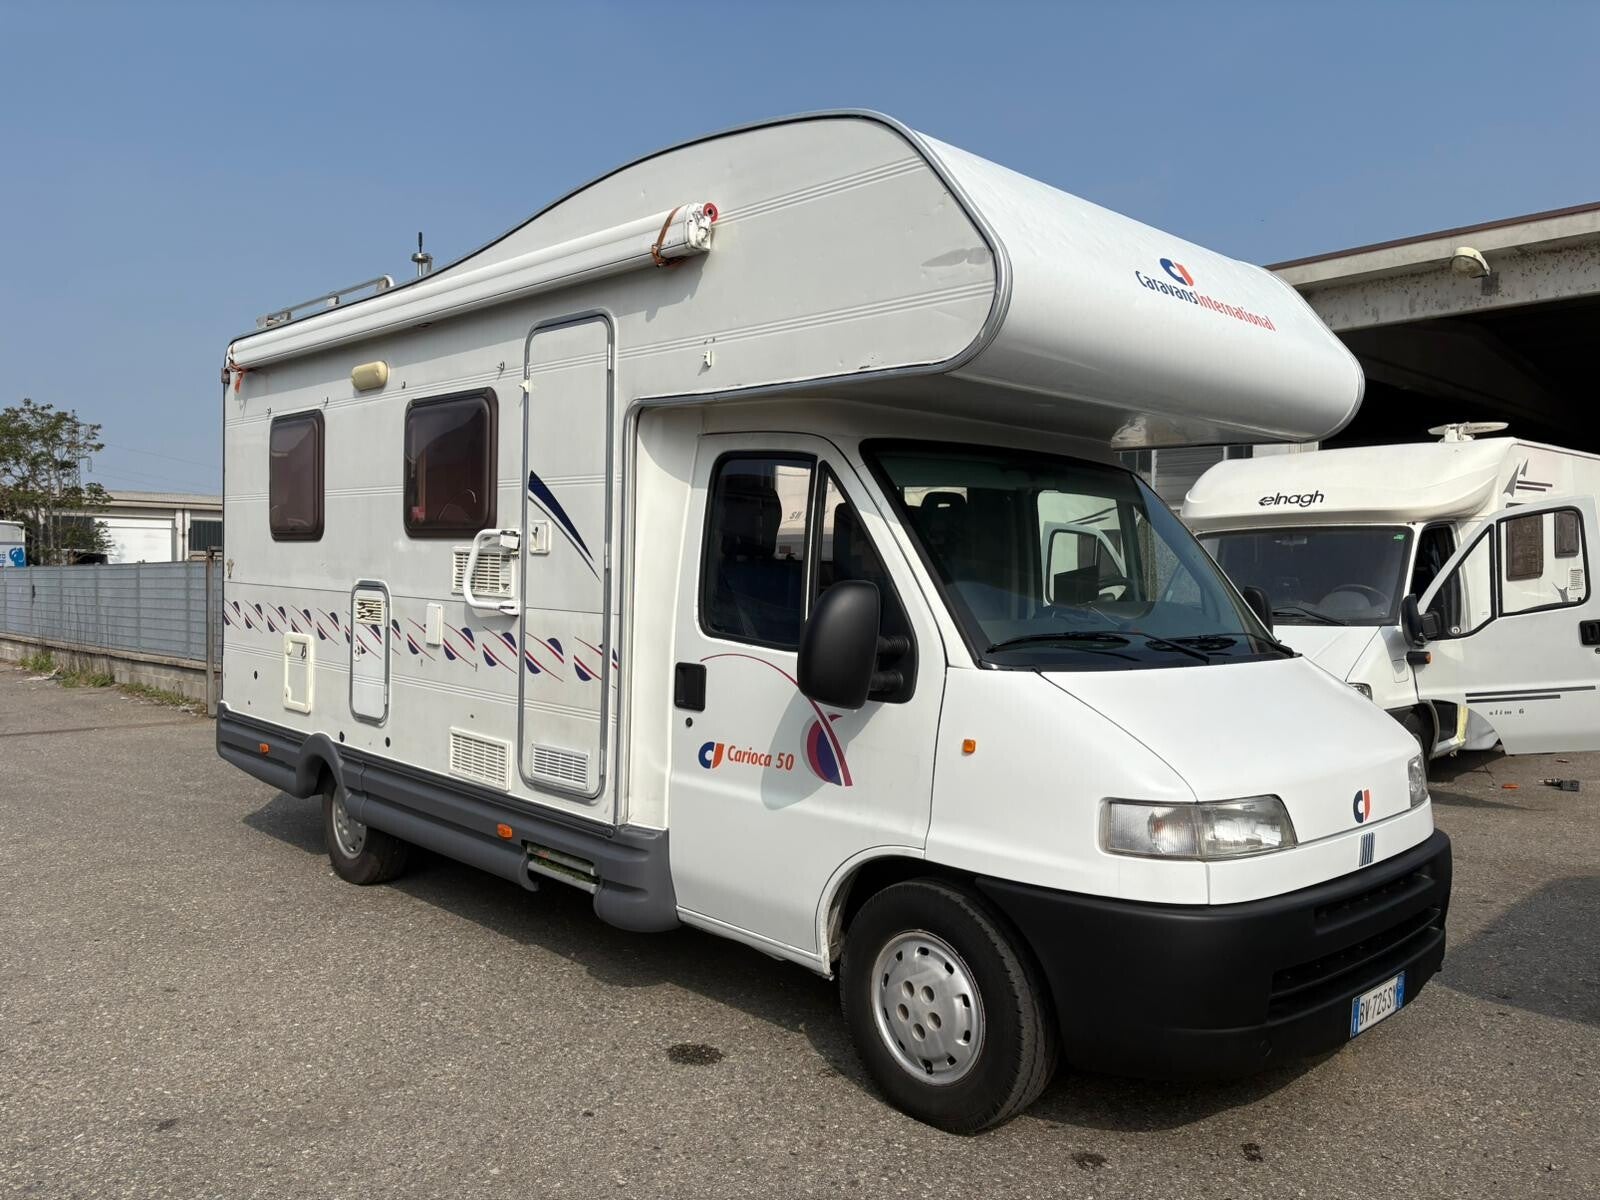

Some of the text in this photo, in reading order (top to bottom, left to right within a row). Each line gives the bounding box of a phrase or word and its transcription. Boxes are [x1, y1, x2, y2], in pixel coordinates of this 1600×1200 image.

[1258, 489, 1325, 508] elnagh
[727, 745, 795, 771] Carioca 50
